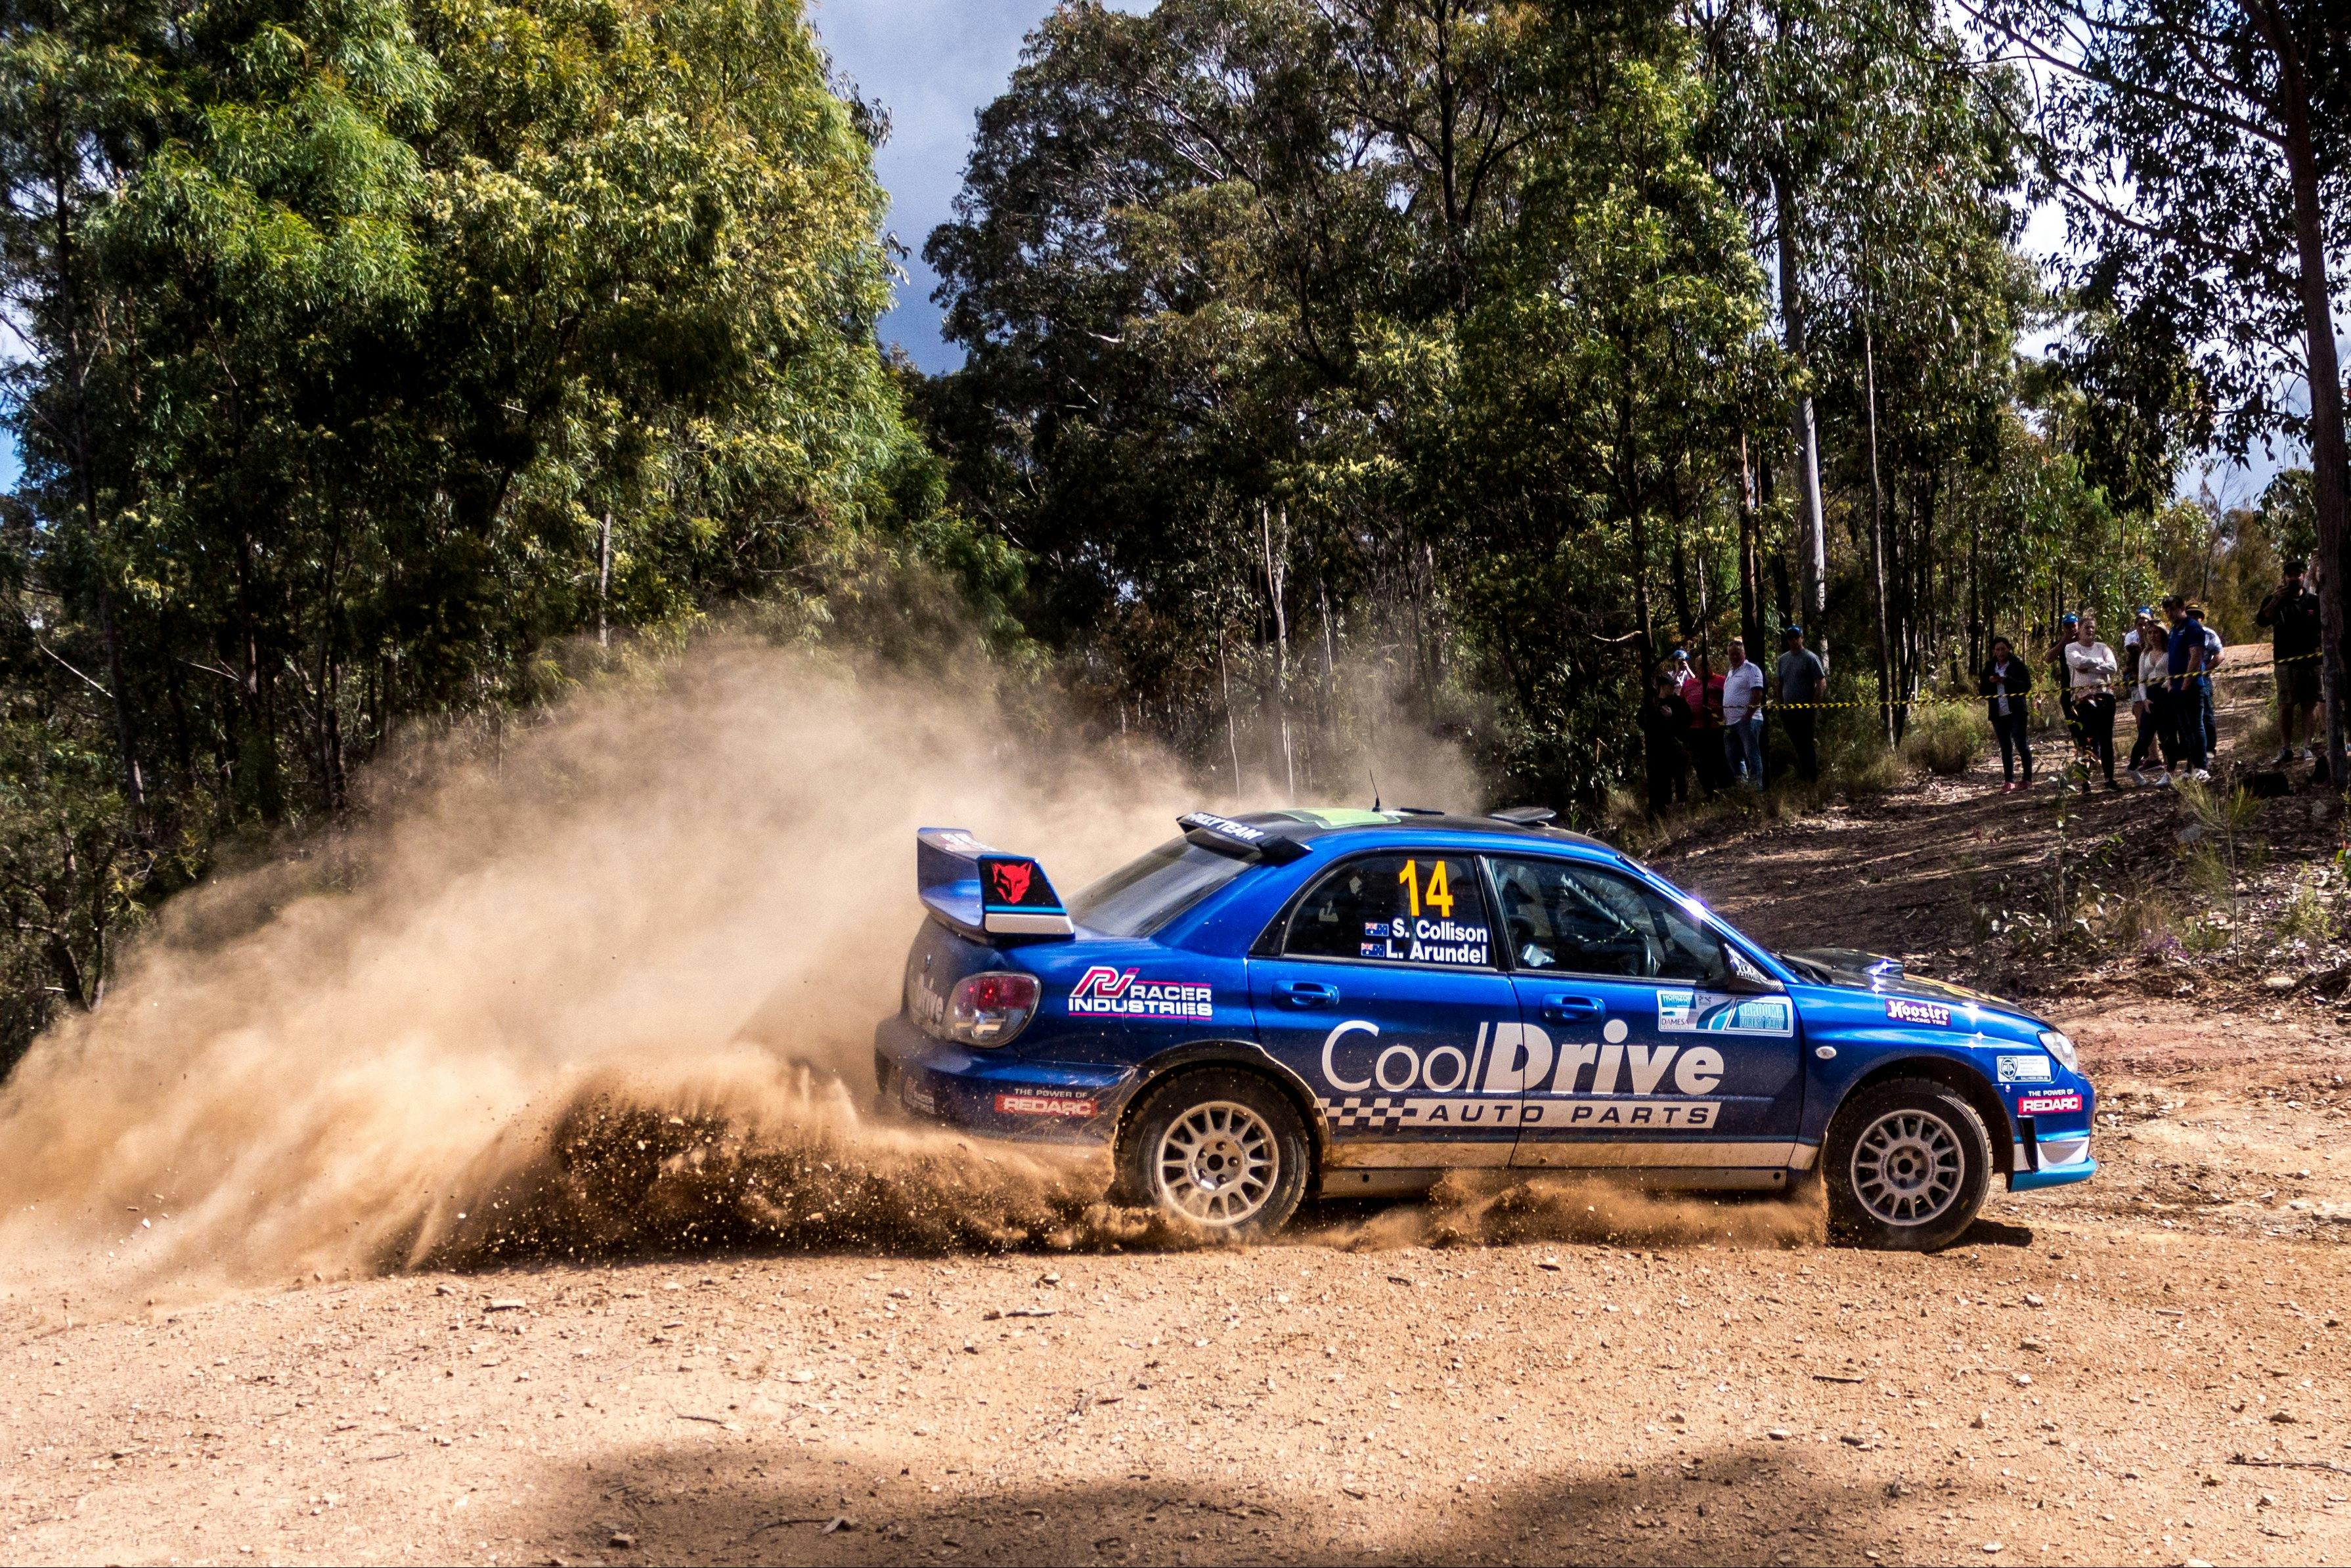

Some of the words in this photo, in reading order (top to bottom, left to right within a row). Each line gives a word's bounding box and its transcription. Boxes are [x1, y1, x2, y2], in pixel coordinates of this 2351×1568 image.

[1216, 820, 1264, 840] TEAM
[1399, 859, 1454, 917] 14
[1392, 917, 1410, 938] S.
[1416, 919, 1488, 942] Collison
[1386, 939, 1404, 959] L.
[1409, 941, 1487, 964] Arundel
[1130, 985, 1212, 1002] RACER
[1068, 998, 1214, 1016] INDUSTRIES
[1738, 1003, 1785, 1018] NAROOMA
[1887, 1000, 1950, 1021] Hoosier
[1036, 1089, 1072, 1099] POWER
[1003, 1097, 1092, 1116] REDARC
[1426, 1104, 1544, 1123] AUTO
[1570, 1106, 1709, 1124] PARTS
[2023, 1097, 2078, 1112] REDARC
